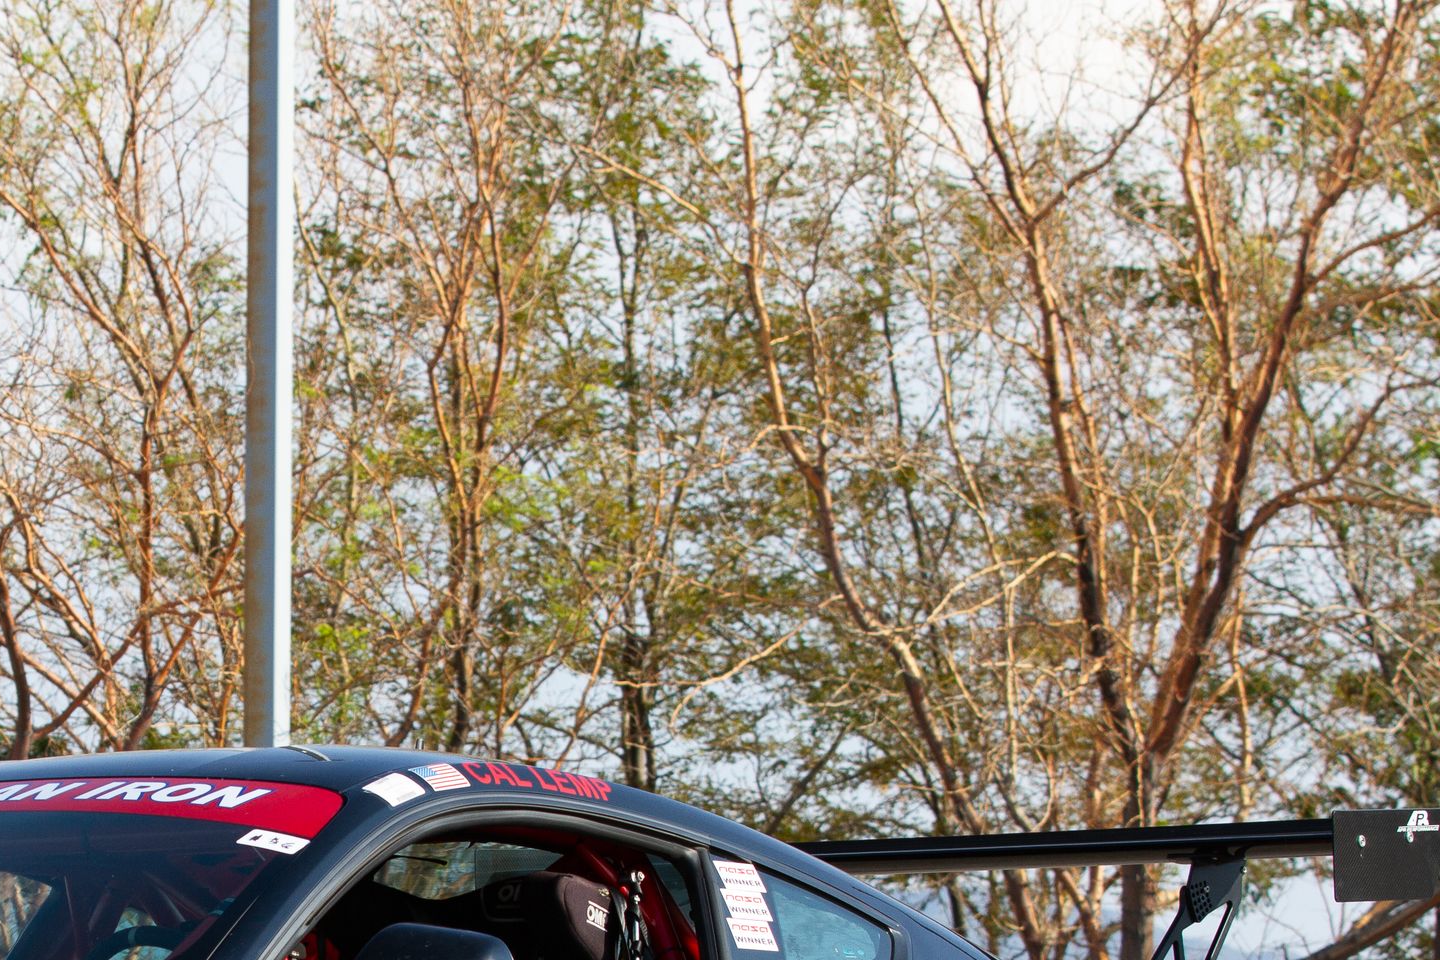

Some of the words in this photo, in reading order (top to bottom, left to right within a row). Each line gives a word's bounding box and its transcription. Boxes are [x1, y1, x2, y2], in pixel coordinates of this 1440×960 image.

[462, 762, 533, 788] CAL
[530, 765, 612, 801] LEMP
[75, 781, 272, 808] IRON
[724, 876, 761, 887] WINNER
[730, 906, 768, 916] WINNER
[735, 935, 774, 946] WINNER
